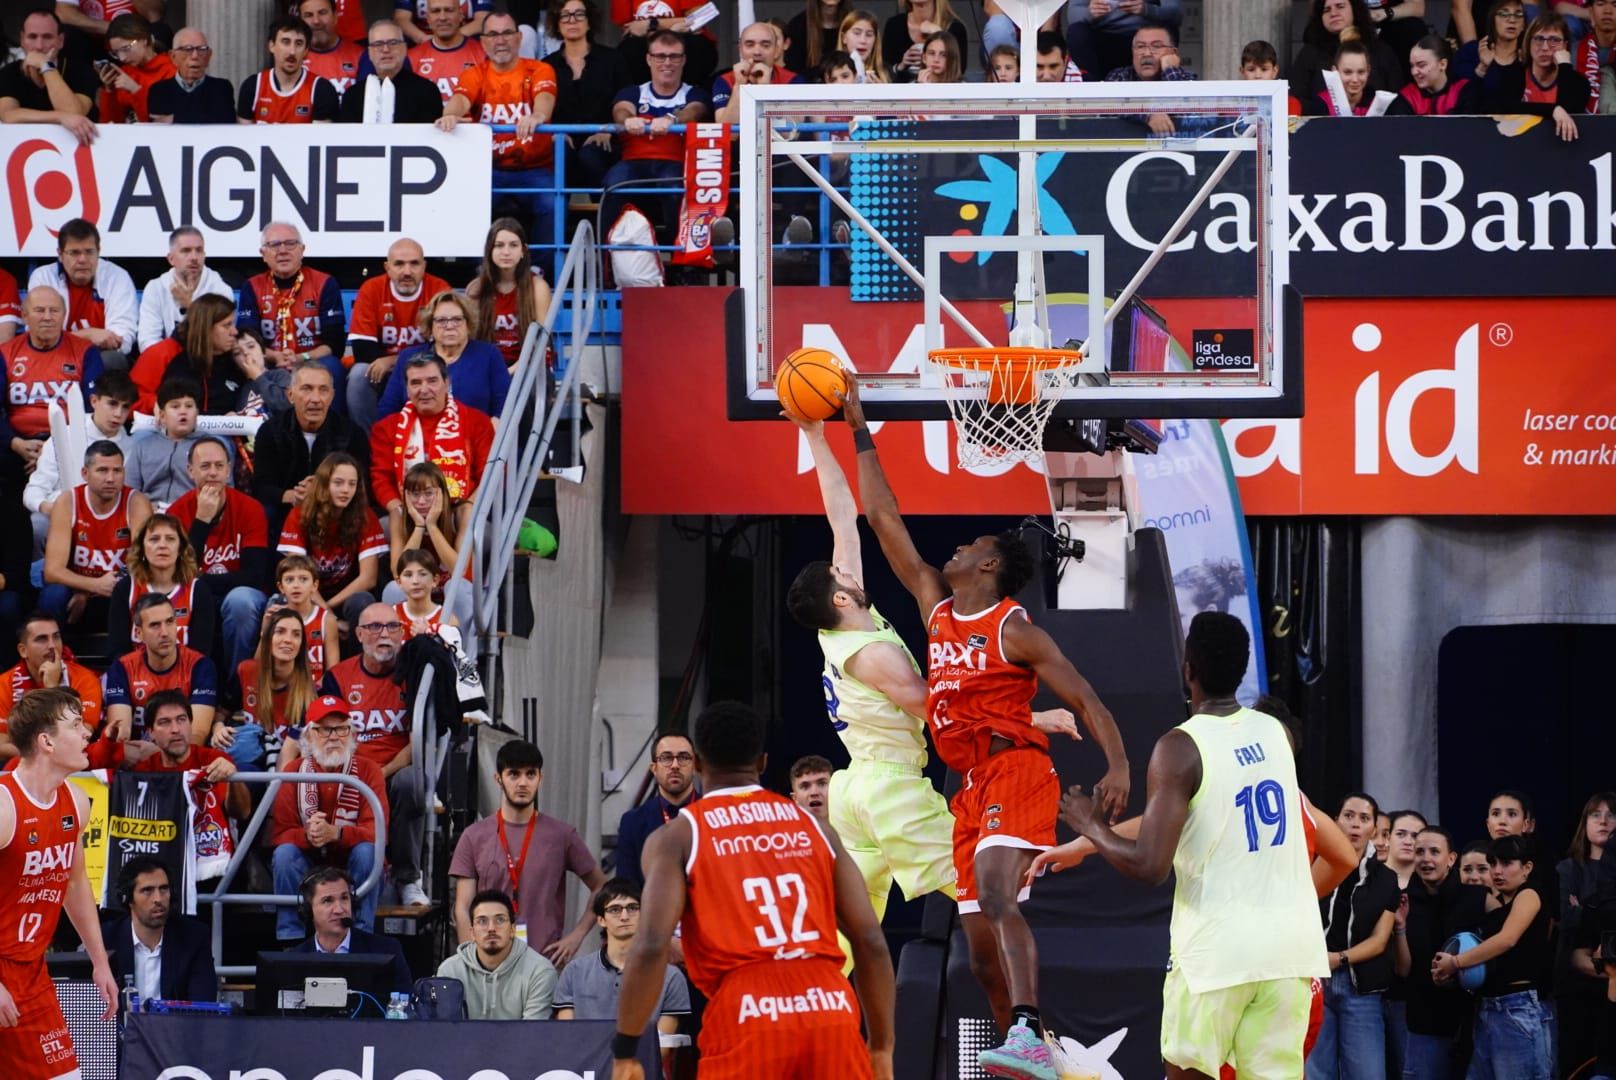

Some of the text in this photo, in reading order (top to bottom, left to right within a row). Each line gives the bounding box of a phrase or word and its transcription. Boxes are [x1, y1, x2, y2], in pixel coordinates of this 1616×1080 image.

[108, 145, 448, 233] AIGNEP
[1105, 150, 1616, 254] CaxaBank
[260, 316, 321, 340] BXI
[382, 325, 427, 345] BAX
[1195, 341, 1221, 355] liga
[1195, 353, 1252, 366] endesa
[1523, 408, 1579, 431] laser
[1523, 443, 1544, 465] &
[73, 545, 128, 571] BAX
[928, 640, 987, 671] BAXI
[347, 709, 408, 733] BAX
[136, 781, 149, 807] 7
[703, 801, 801, 830] OBASOHAN
[1234, 778, 1288, 853] 19
[111, 819, 176, 839] MOZZART
[135, 840, 160, 854] NIS
[711, 831, 812, 857] inmoovs
[22, 842, 76, 876] BAXI
[742, 872, 821, 948] 32
[738, 986, 853, 1025] Aquaflix
[41, 1039, 65, 1056] ETL
